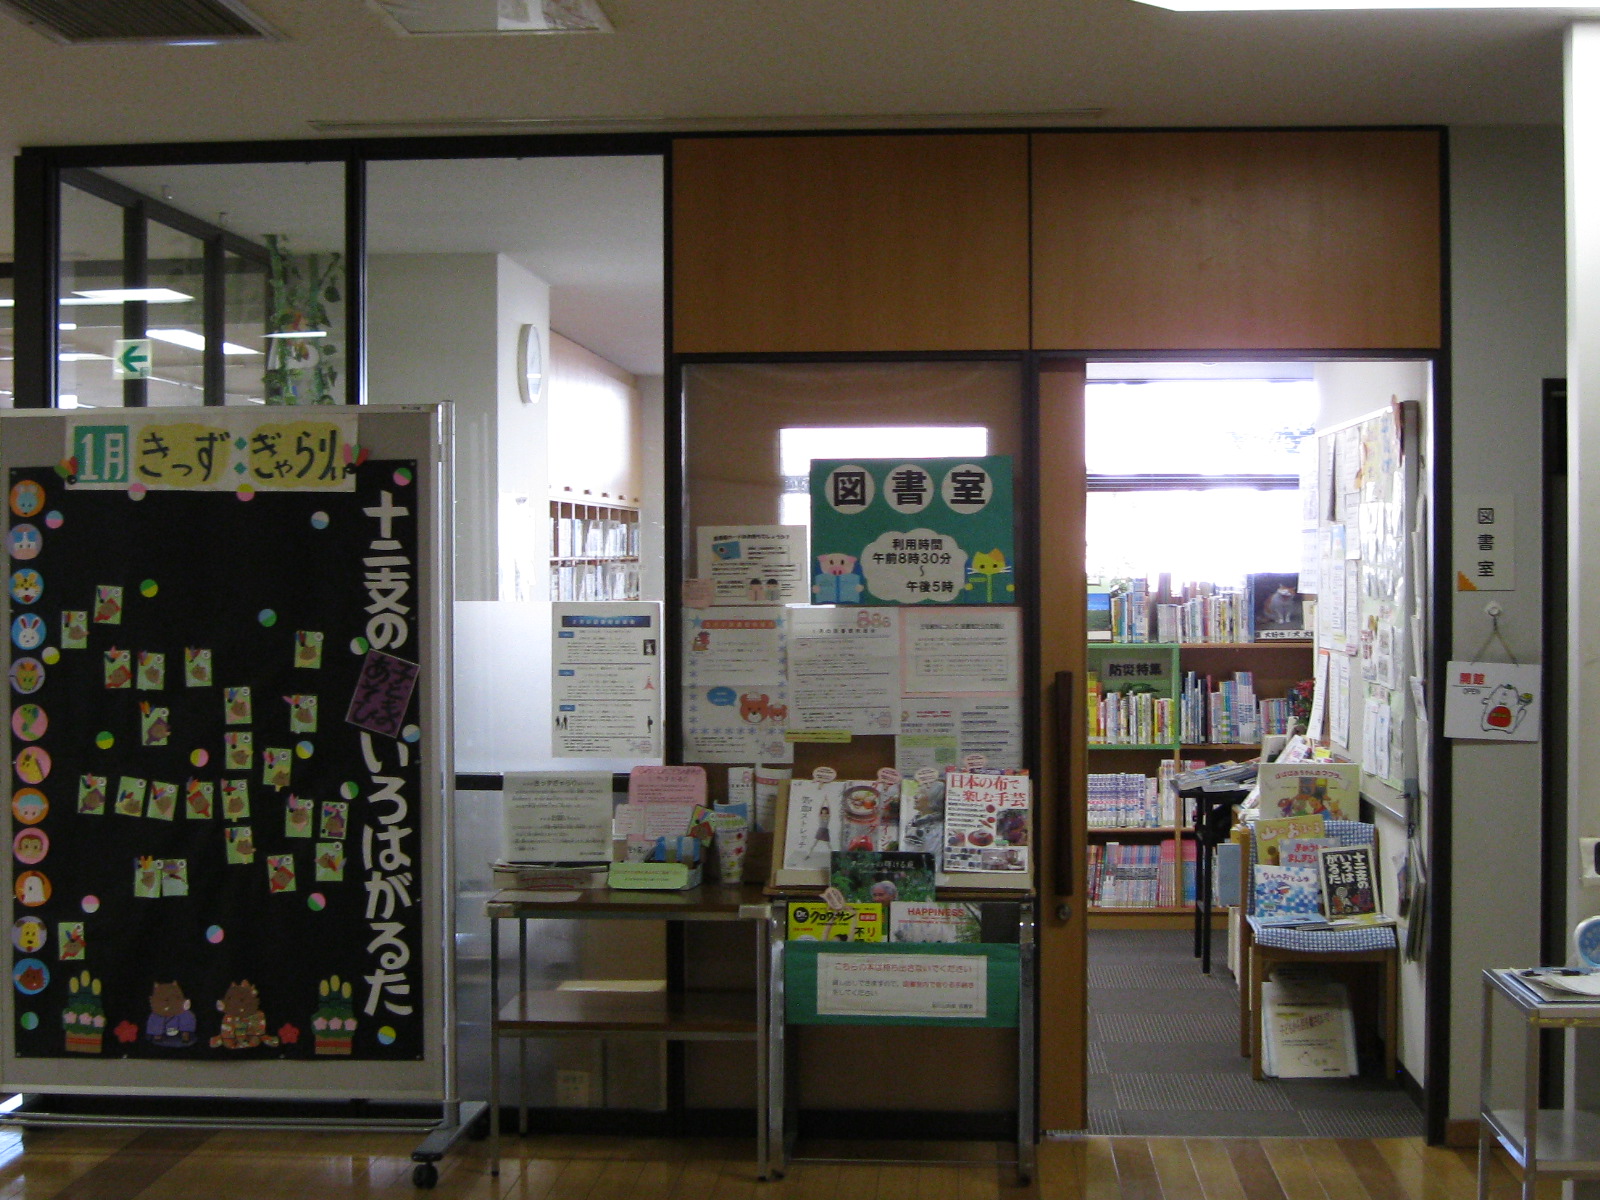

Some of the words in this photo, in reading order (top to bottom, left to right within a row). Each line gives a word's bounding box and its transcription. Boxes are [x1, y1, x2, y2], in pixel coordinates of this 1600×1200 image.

[79, 433, 126, 481] 1月
[139, 431, 230, 482] きっず
[833, 470, 986, 508] 図書室
[892, 538, 943, 552] 利用時間
[1477, 507, 1495, 577] 図書室
[362, 490, 412, 650] 十二支の
[872, 552, 953, 565] 午前8時30分
[906, 581, 954, 593] 午後5時
[1108, 662, 1163, 678] 防災特集
[951, 774, 1021, 791] 日本の布で
[963, 790, 1027, 807] 楽しむ手芸
[360, 731, 414, 1017] いろはがるた
[1326, 854, 1342, 884] がるた
[1340, 854, 1355, 883] いろは
[1352, 851, 1370, 889] 十二支の
[907, 908, 965, 917] HAPPINESS
